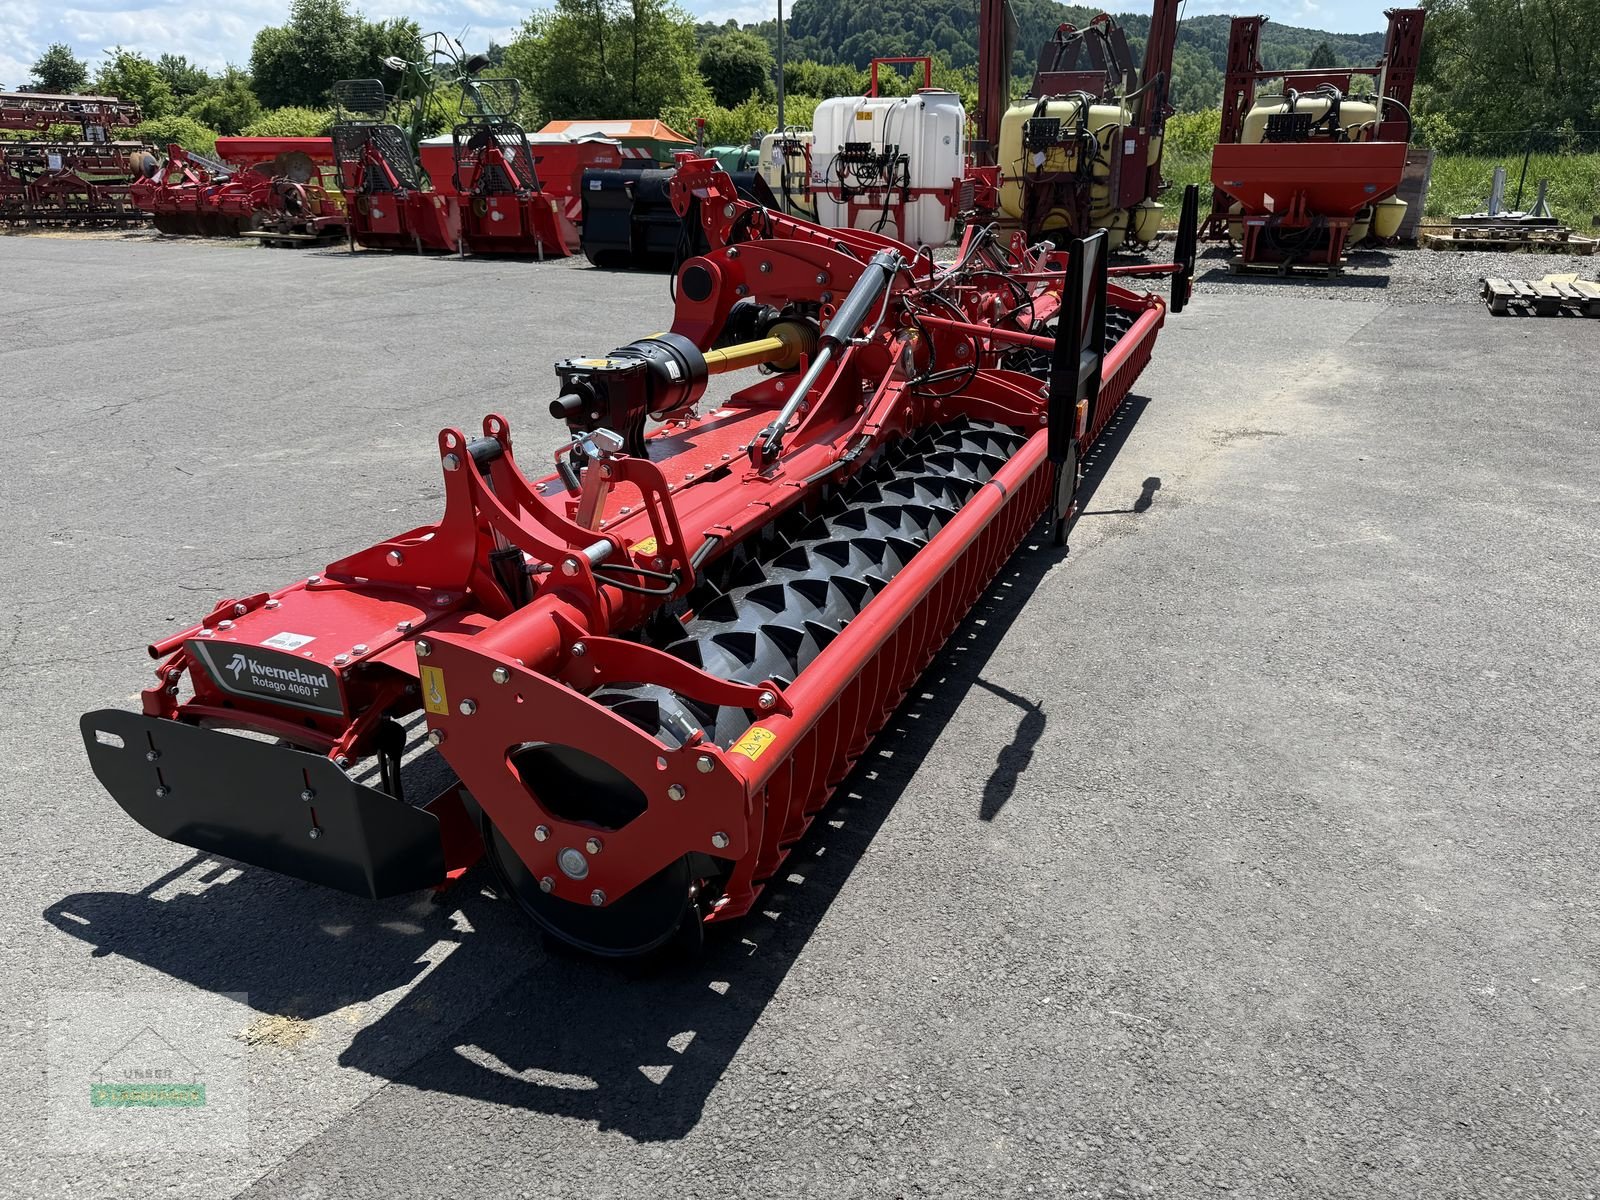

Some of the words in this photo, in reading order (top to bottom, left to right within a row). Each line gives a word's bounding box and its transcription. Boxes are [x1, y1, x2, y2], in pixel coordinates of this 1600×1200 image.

[248, 659, 329, 688] Kverneland
[251, 676, 286, 692] Rotago
[288, 683, 311, 697] 4060
[313, 688, 320, 697] F
